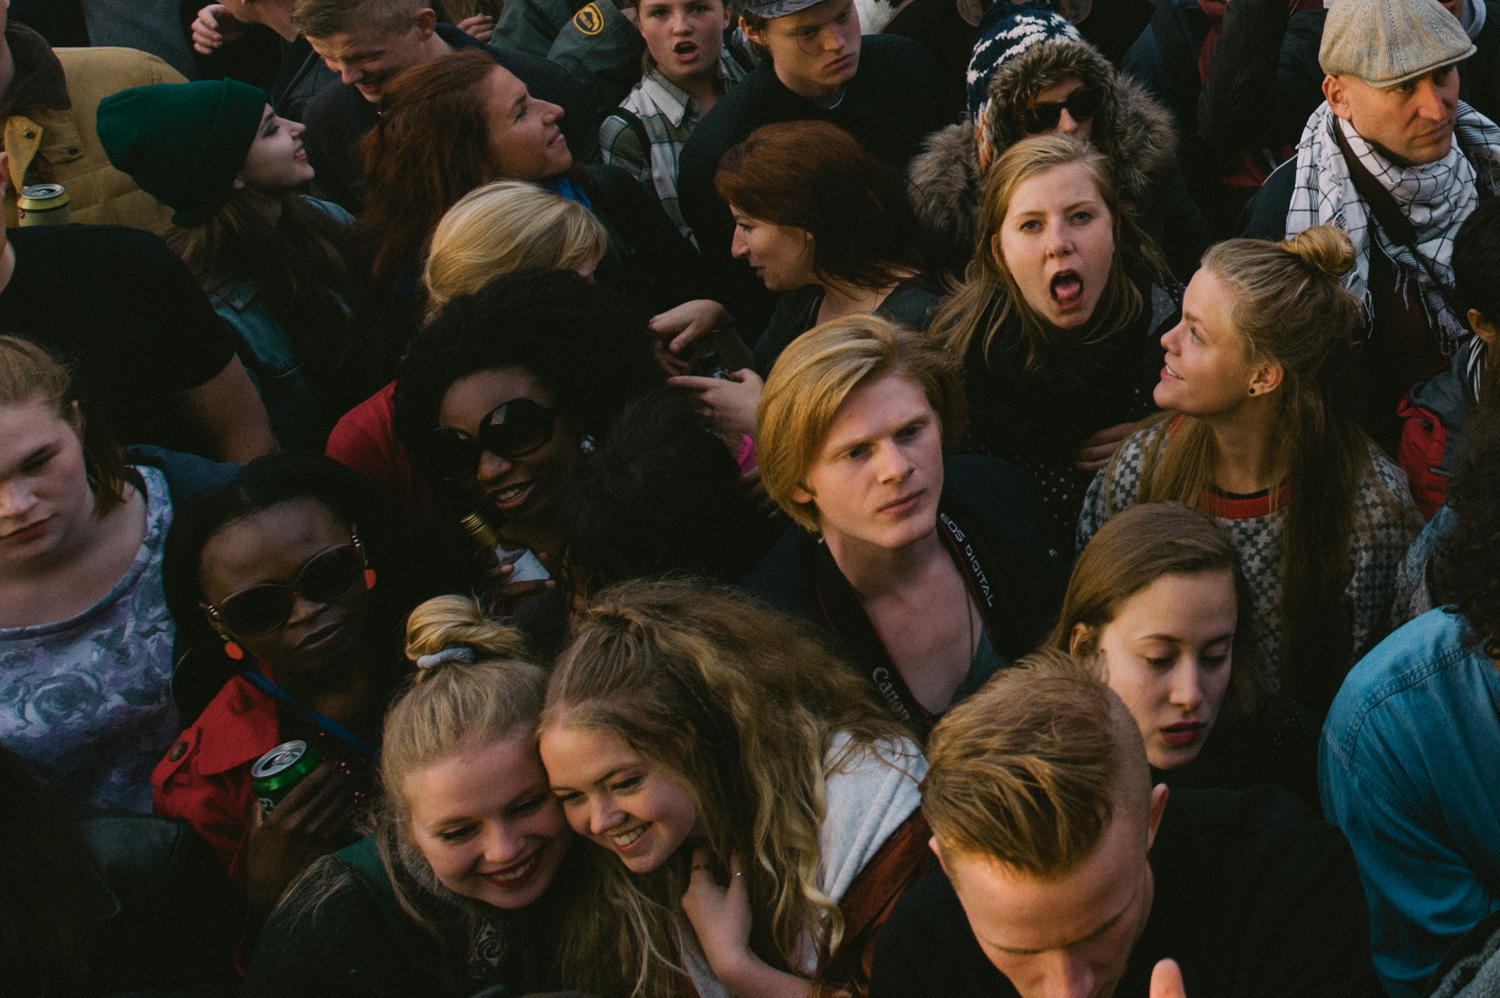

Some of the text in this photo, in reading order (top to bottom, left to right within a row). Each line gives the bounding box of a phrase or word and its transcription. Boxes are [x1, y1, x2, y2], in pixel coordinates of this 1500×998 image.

[940, 512, 994, 607] EOS DIGITAL
[872, 666, 911, 722] Canon
